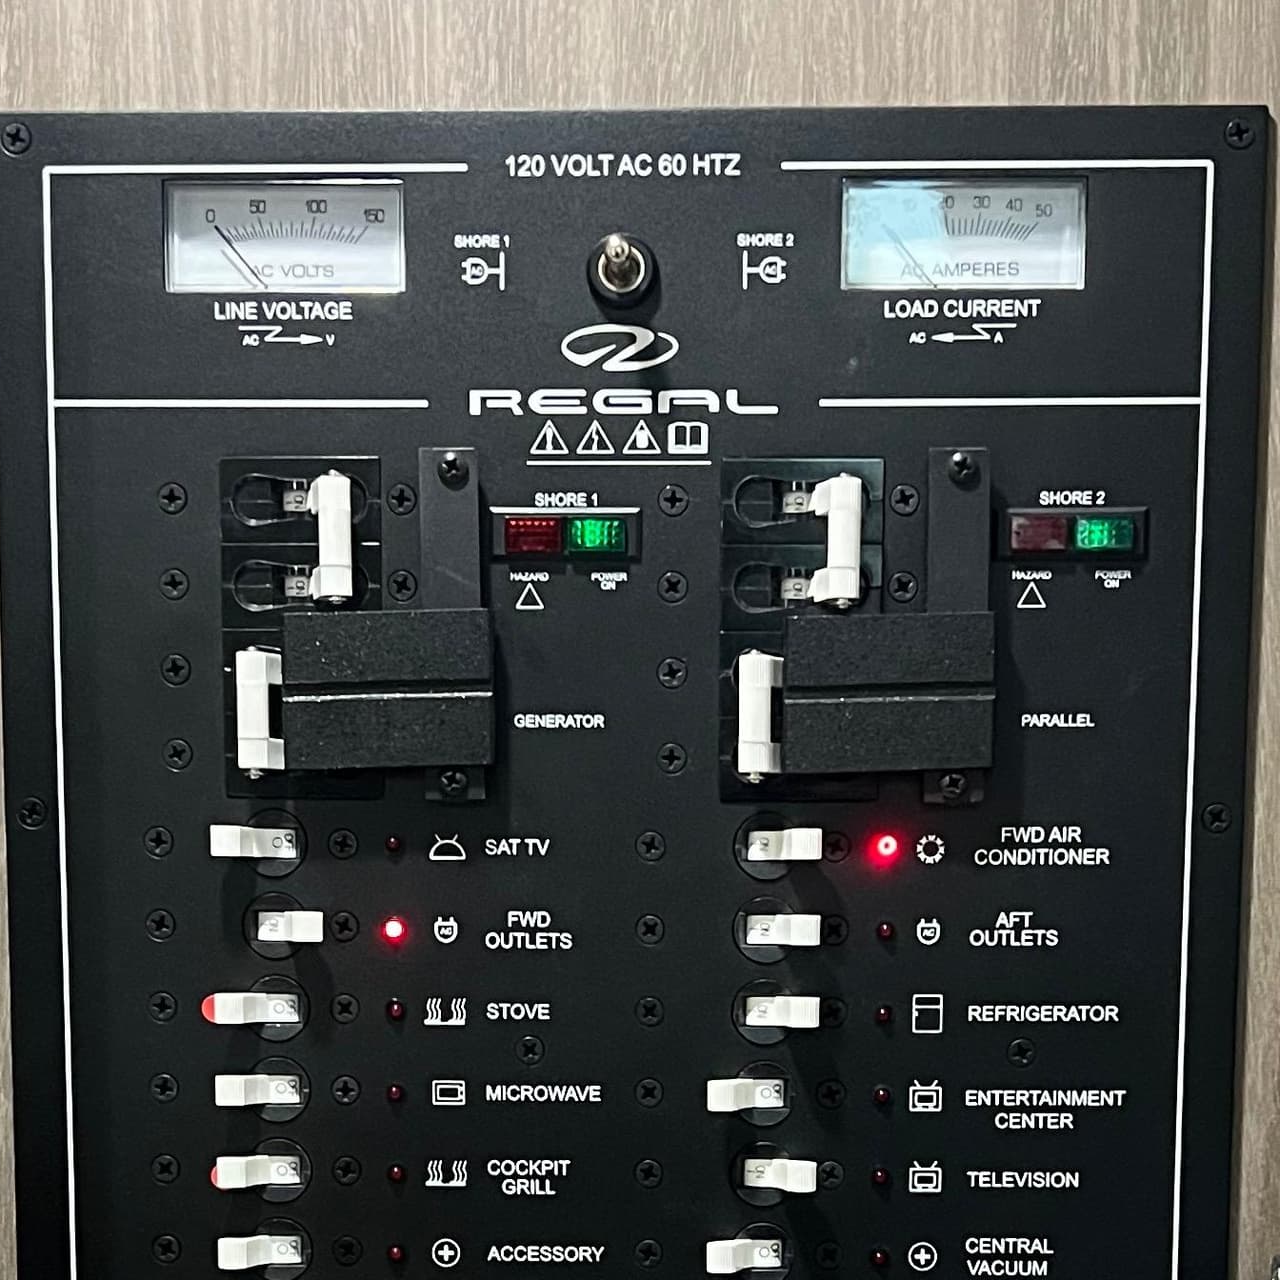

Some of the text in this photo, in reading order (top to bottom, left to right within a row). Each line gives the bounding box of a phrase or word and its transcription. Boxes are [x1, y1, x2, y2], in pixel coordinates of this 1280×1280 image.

[505, 153, 740, 177] 120 VOLT AC 60 HTZ
[206, 200, 384, 223] 0 50 100 150
[973, 196, 990, 209] 30
[1006, 199, 1022, 212] 40
[1036, 204, 1052, 217] 50
[454, 234, 509, 248] SHORE 1
[737, 233, 794, 247] SHORE 2
[281, 265, 334, 277] VOLTS
[932, 262, 1019, 277] AMPERES
[214, 301, 353, 320] LINE VOLTAGE
[884, 299, 1041, 318] LOAD CURRENT
[242, 334, 336, 346] AC V
[909, 332, 1004, 345] AC A
[468, 388, 778, 416] REGAL
[534, 493, 598, 507] SHORE 1
[1039, 491, 1105, 505] SHORE 2
[514, 714, 604, 728] GENERATOR
[1022, 714, 1094, 727] PARALLEL
[1002, 827, 1081, 843] FWD AIR
[485, 839, 550, 855] SAT TV
[975, 848, 1109, 865] CONDITIONER
[508, 911, 551, 927] FWD
[996, 912, 1033, 928] AFT
[486, 932, 572, 949] OUTLETS
[970, 930, 1058, 946] OUTLETS
[487, 1003, 550, 1019] STOVE
[968, 1006, 1118, 1021] REFRIGERATOR
[486, 1085, 601, 1101] MICROWAVE
[966, 1090, 1126, 1106] ENTERTAINMENT
[995, 1113, 1073, 1129] CENTER
[488, 1160, 570, 1175] COCKPIT
[502, 1179, 555, 1194] GRILL
[967, 1171, 1079, 1188] TELEVISION
[966, 1238, 1053, 1253] CENTRAL
[488, 1246, 604, 1262] ACCESSORY
[967, 1260, 1047, 1276] VACUUM
